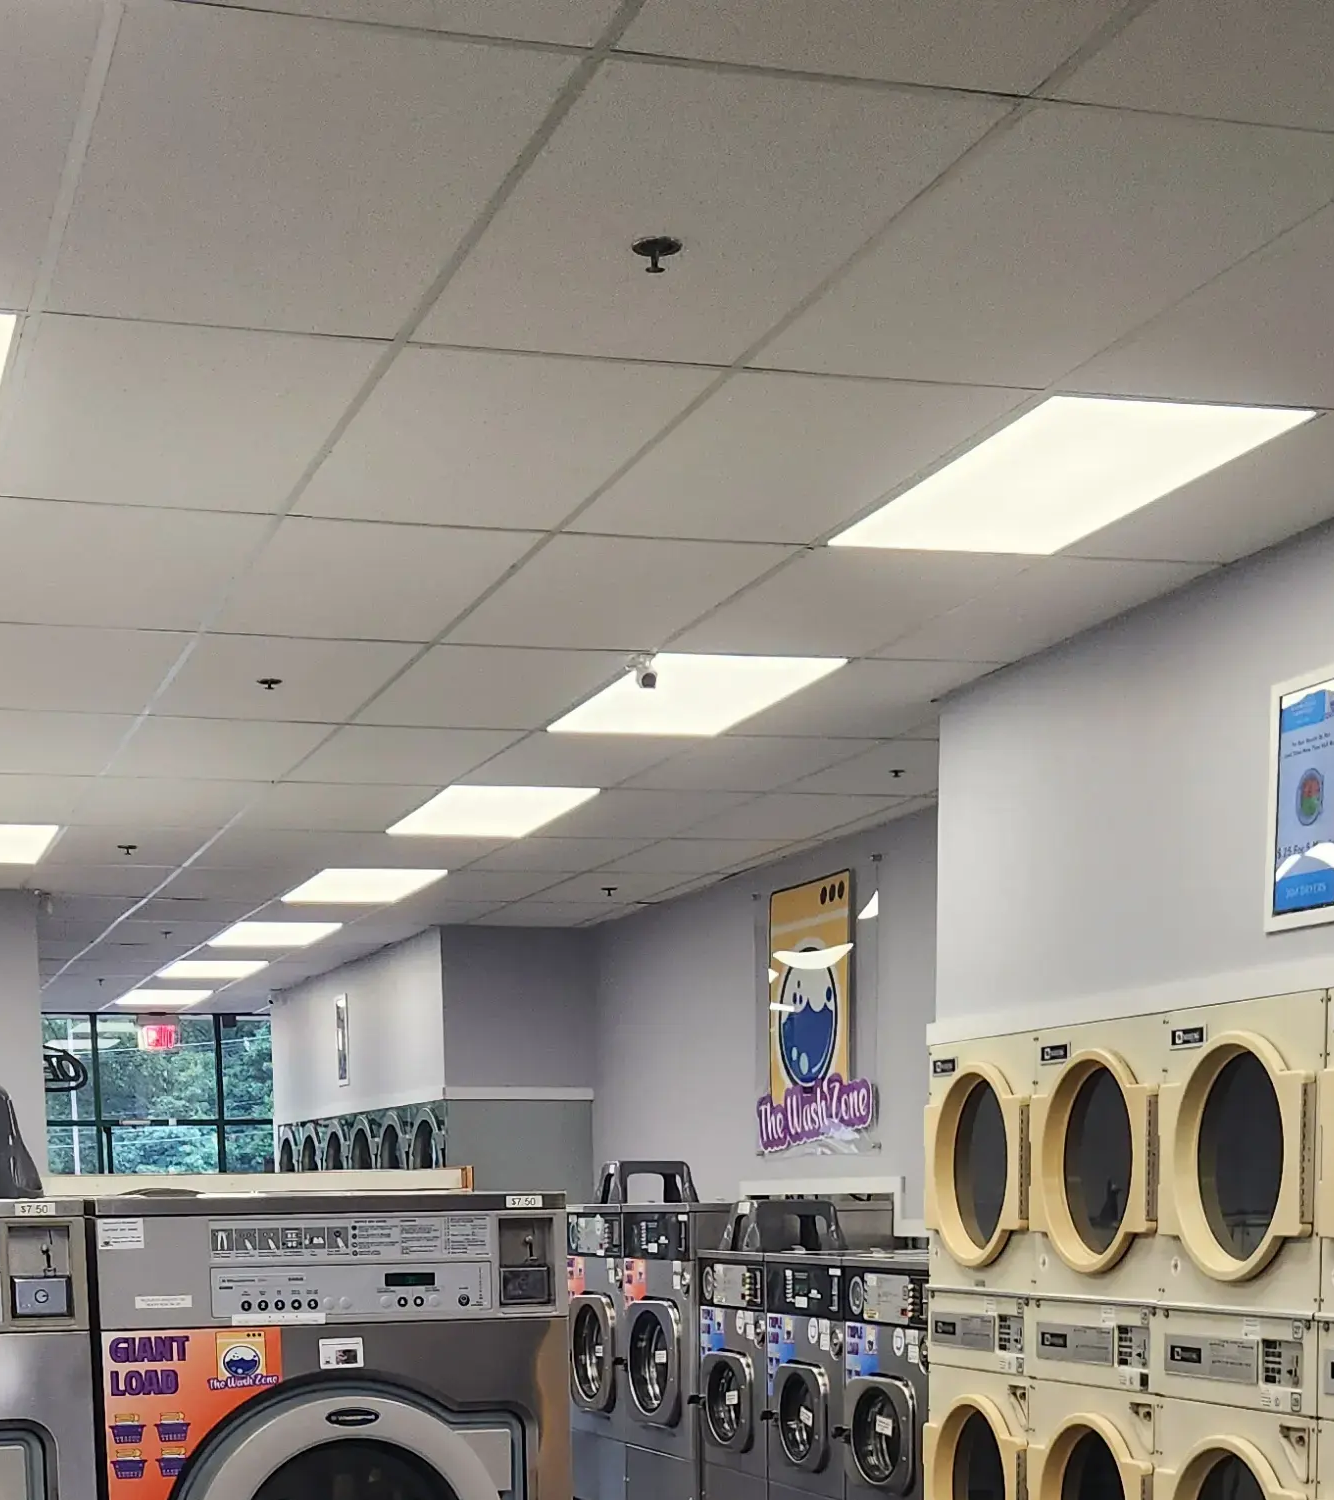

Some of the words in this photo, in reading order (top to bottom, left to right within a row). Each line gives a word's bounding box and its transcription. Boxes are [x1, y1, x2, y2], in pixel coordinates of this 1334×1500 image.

[759, 1102, 785, 1141] The
[786, 1087, 828, 1135] Wash
[826, 1081, 868, 1123] Zone
[109, 1335, 190, 1363] GIANT
[110, 1369, 179, 1397] LOAD
[227, 1375, 254, 1388] Wash
